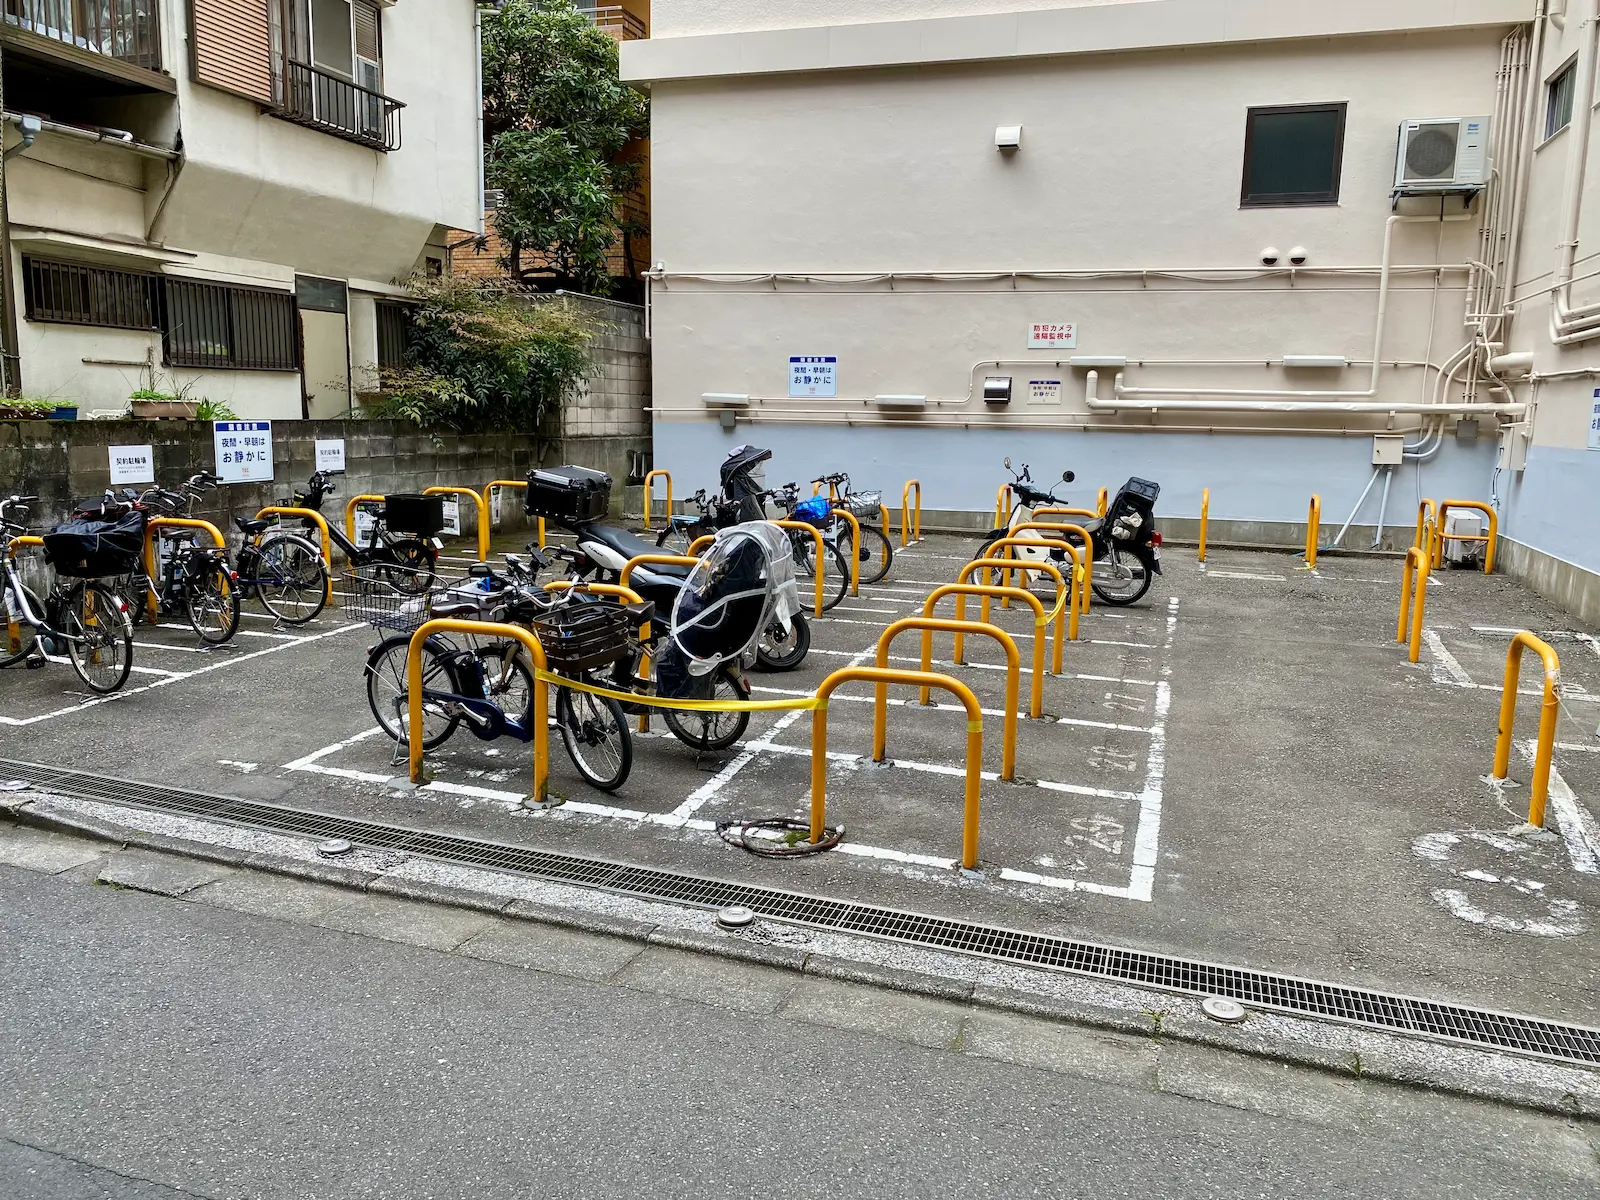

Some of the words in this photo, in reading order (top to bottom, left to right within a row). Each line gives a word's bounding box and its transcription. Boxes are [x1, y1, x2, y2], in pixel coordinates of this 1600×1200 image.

[1033, 324, 1073, 332] 防犯カメラ
[794, 375, 832, 385] お静かに
[221, 437, 266, 448] 夜間・早朝は
[222, 450, 267, 464] お静かに
